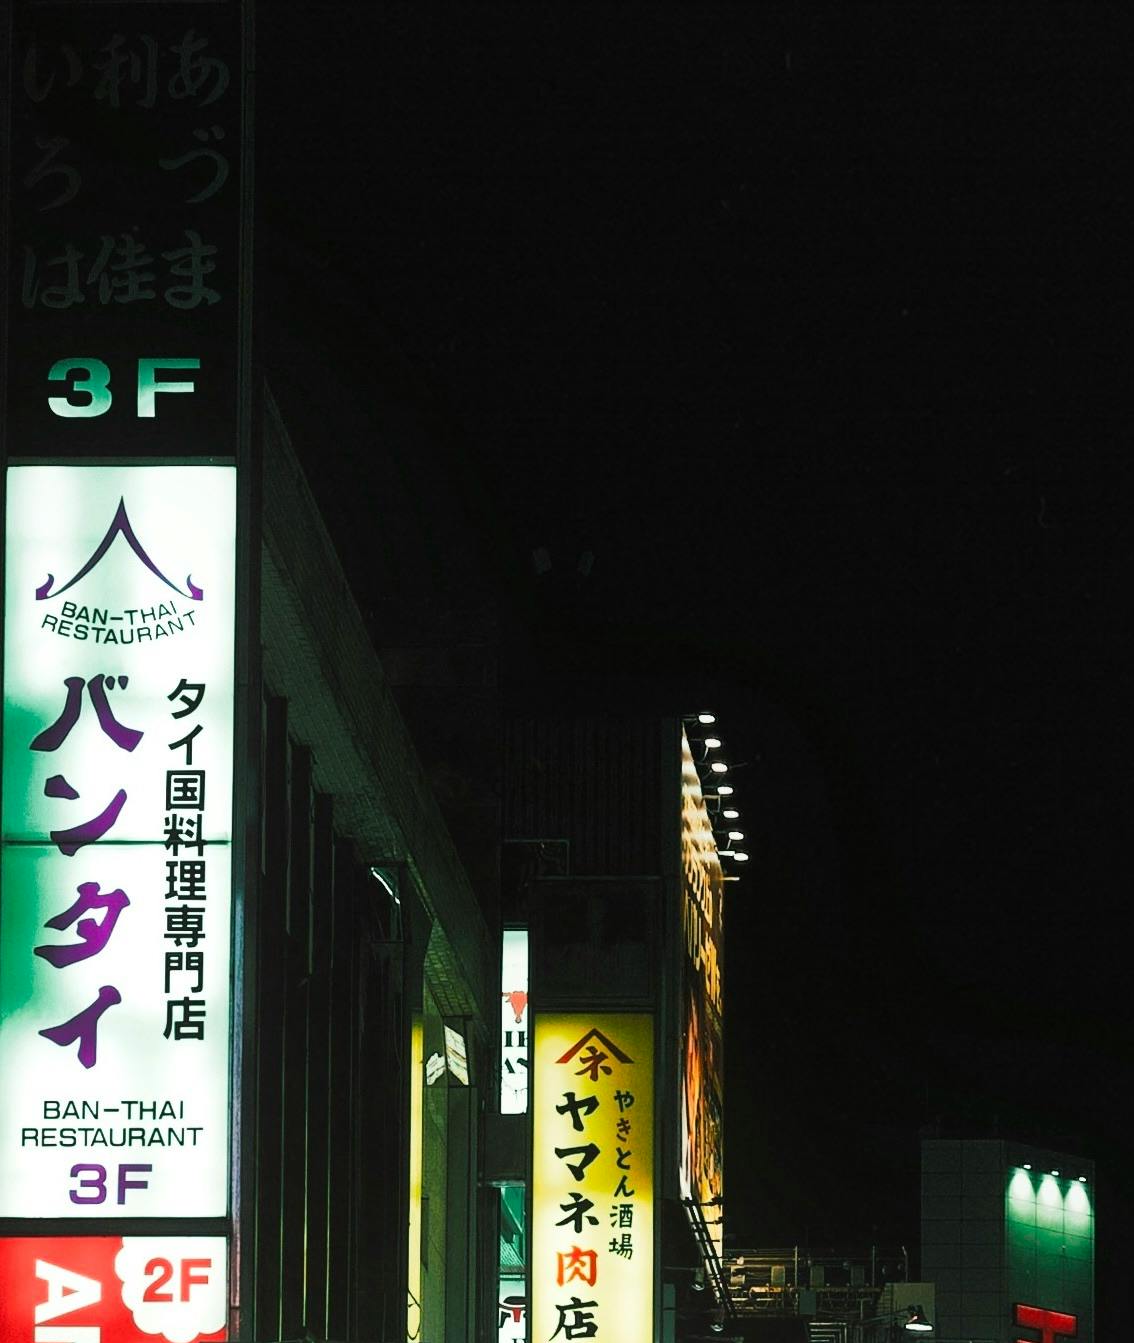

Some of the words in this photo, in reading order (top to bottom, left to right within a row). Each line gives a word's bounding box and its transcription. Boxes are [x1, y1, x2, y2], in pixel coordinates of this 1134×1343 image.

[47, 356, 200, 419] 3F
[41, 609, 197, 646] RESTAURANT
[60, 600, 178, 627] BAN-THAI
[29, 672, 145, 1070] バンタイ
[163, 678, 208, 1041] タイ国料理専門店
[43, 1100, 185, 1121] BAN-THAI
[21, 1127, 204, 1148] RESTAURANT
[69, 1163, 153, 1205] 3F
[607, 1089, 636, 1262] やきとん酒場
[548, 1090, 601, 1342] ヤマネ肉店
[142, 1257, 212, 1303] 2F
